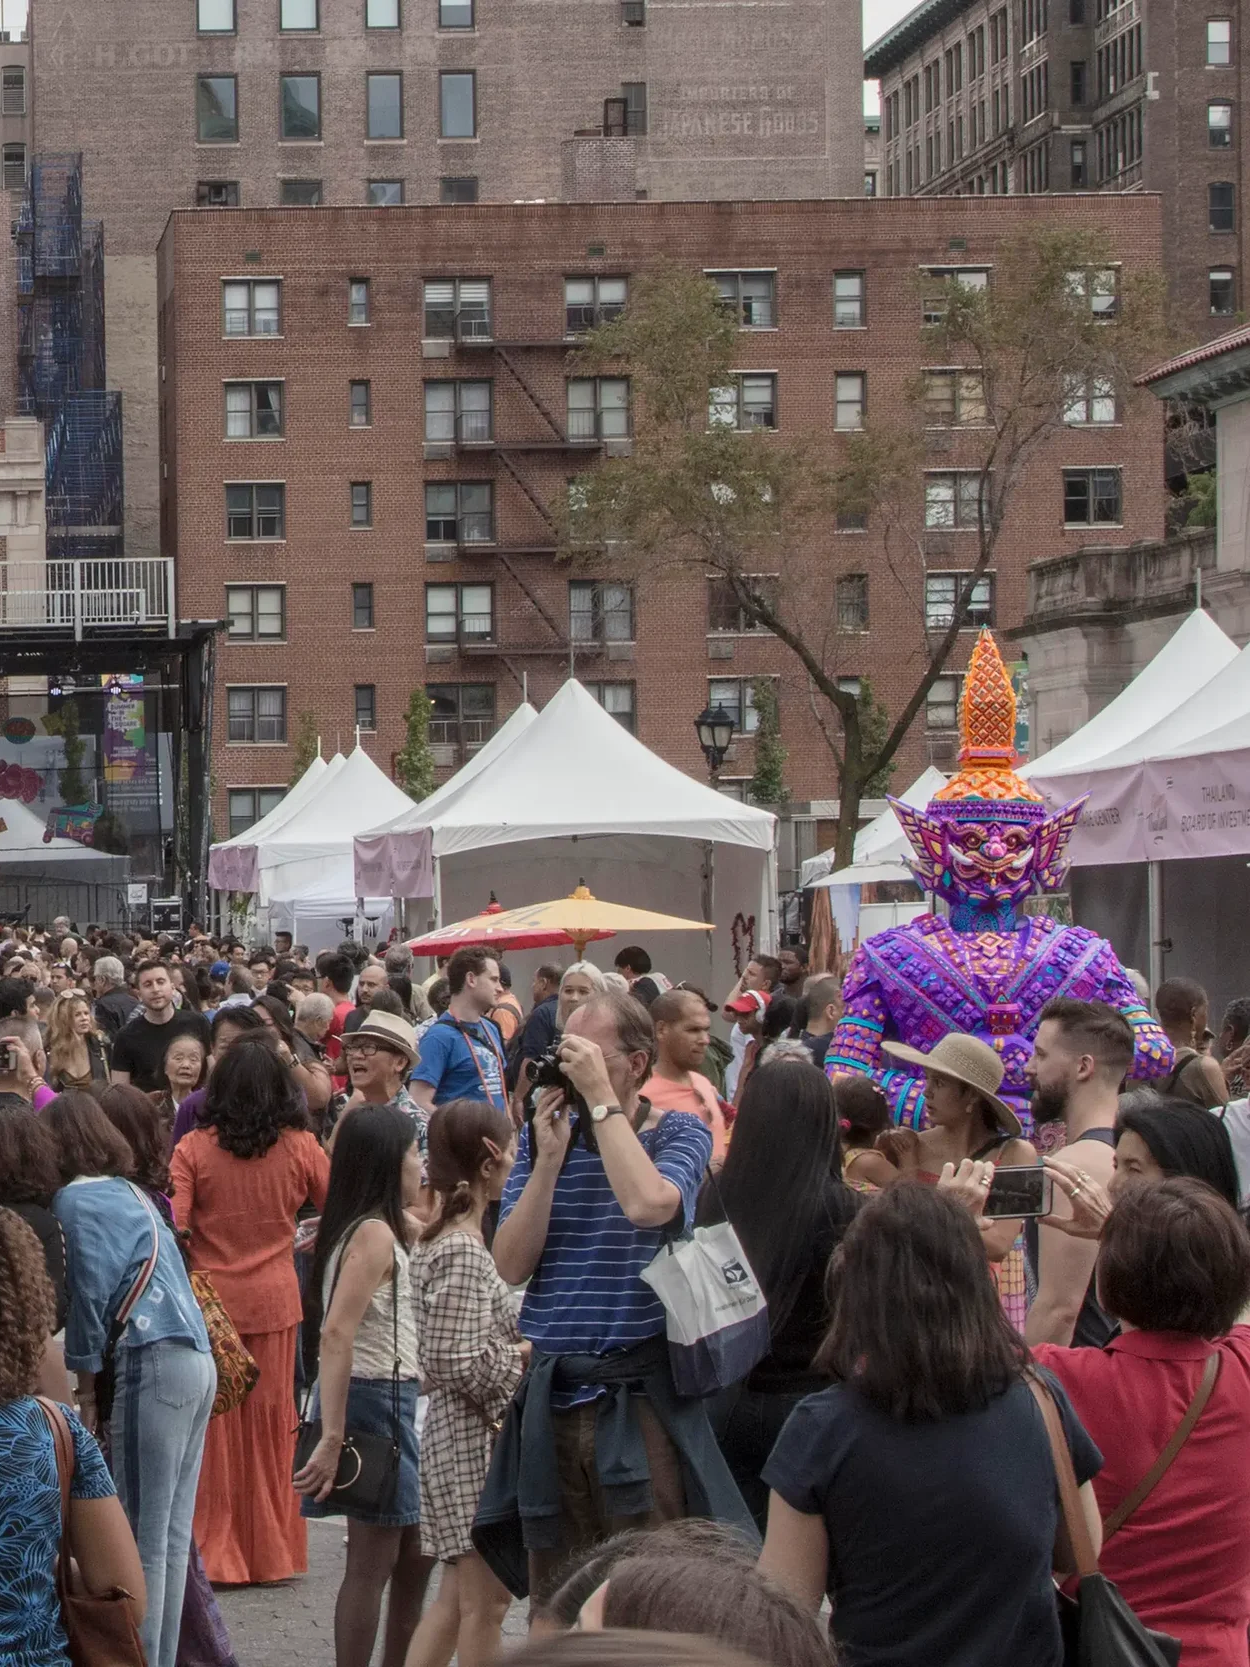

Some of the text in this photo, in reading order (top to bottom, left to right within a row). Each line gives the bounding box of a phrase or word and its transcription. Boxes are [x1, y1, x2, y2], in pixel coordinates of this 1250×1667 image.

[1201, 784, 1236, 803] THAILAND
[1095, 807, 1123, 827] CENTER
[1181, 814, 1207, 832] BOARD
